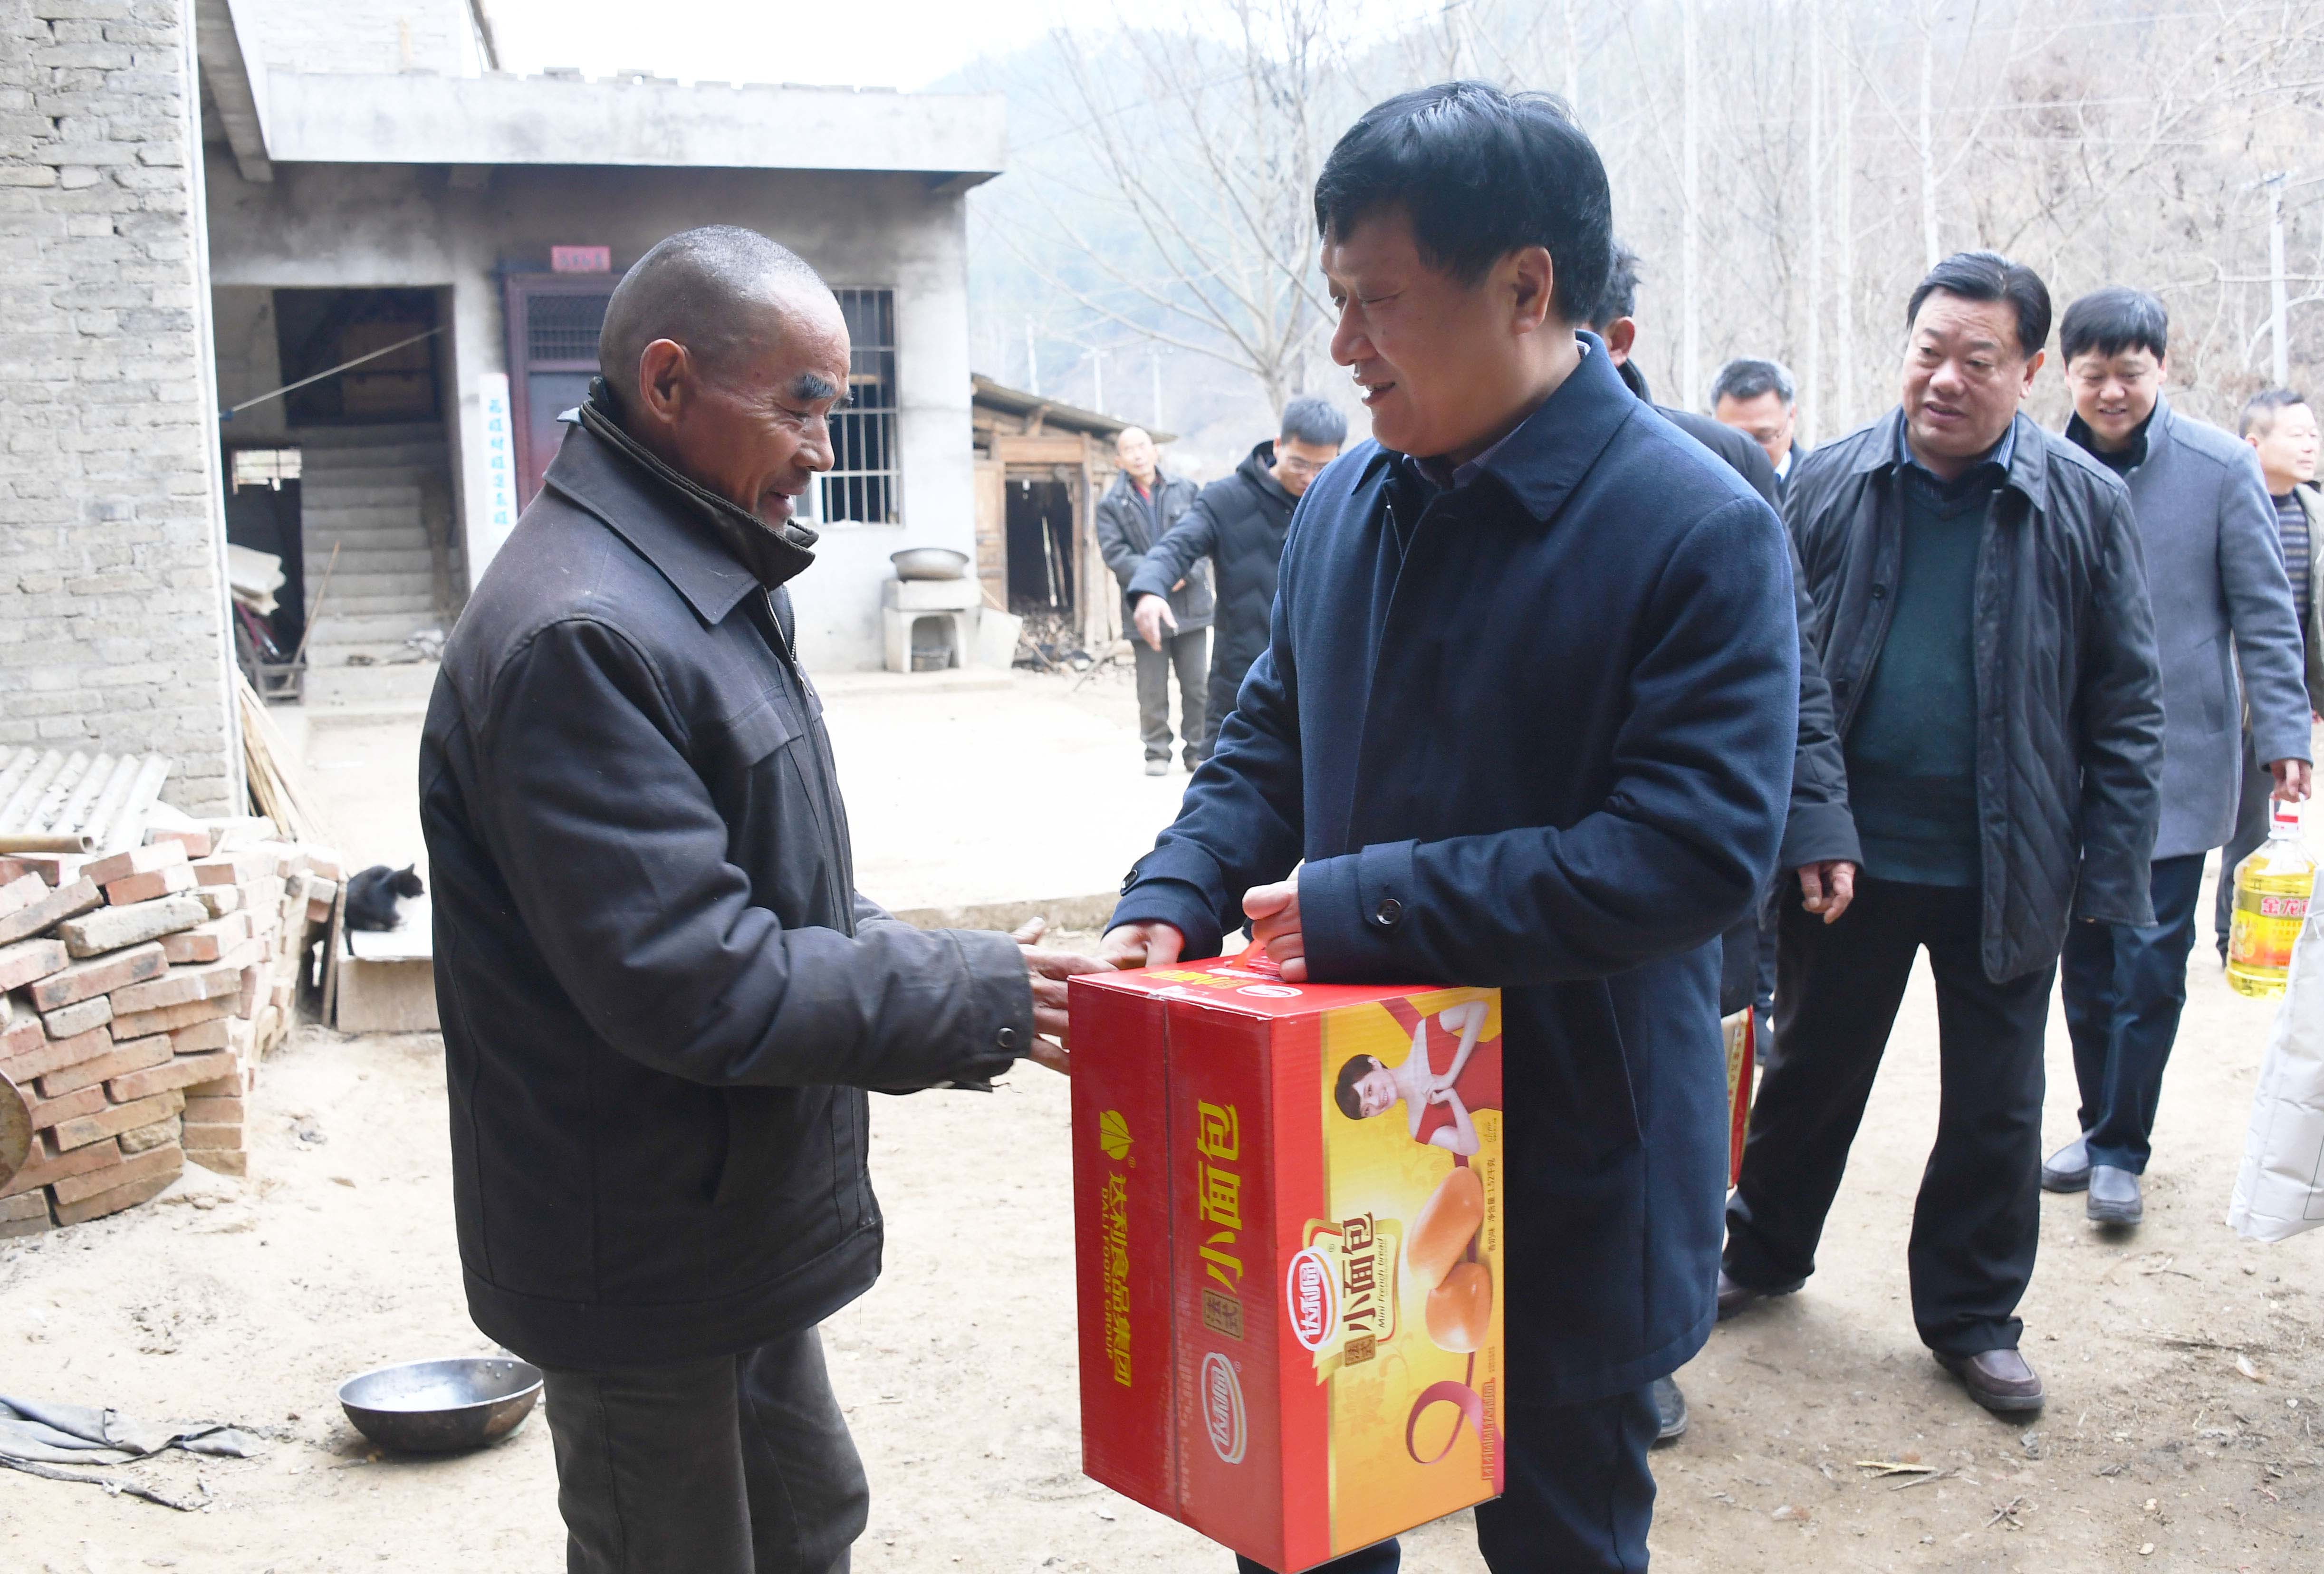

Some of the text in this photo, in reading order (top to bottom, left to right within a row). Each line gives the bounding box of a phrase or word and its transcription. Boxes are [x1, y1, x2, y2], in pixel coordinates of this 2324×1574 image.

[1102, 1188, 1113, 1359] DALI FOODS GROUP
[1109, 1171, 1131, 1388] 达利食品集团
[1197, 1099, 1243, 1293] 小面包
[1342, 1211, 1375, 1331] 小面包
[1299, 1262, 1322, 1338] 达利园
